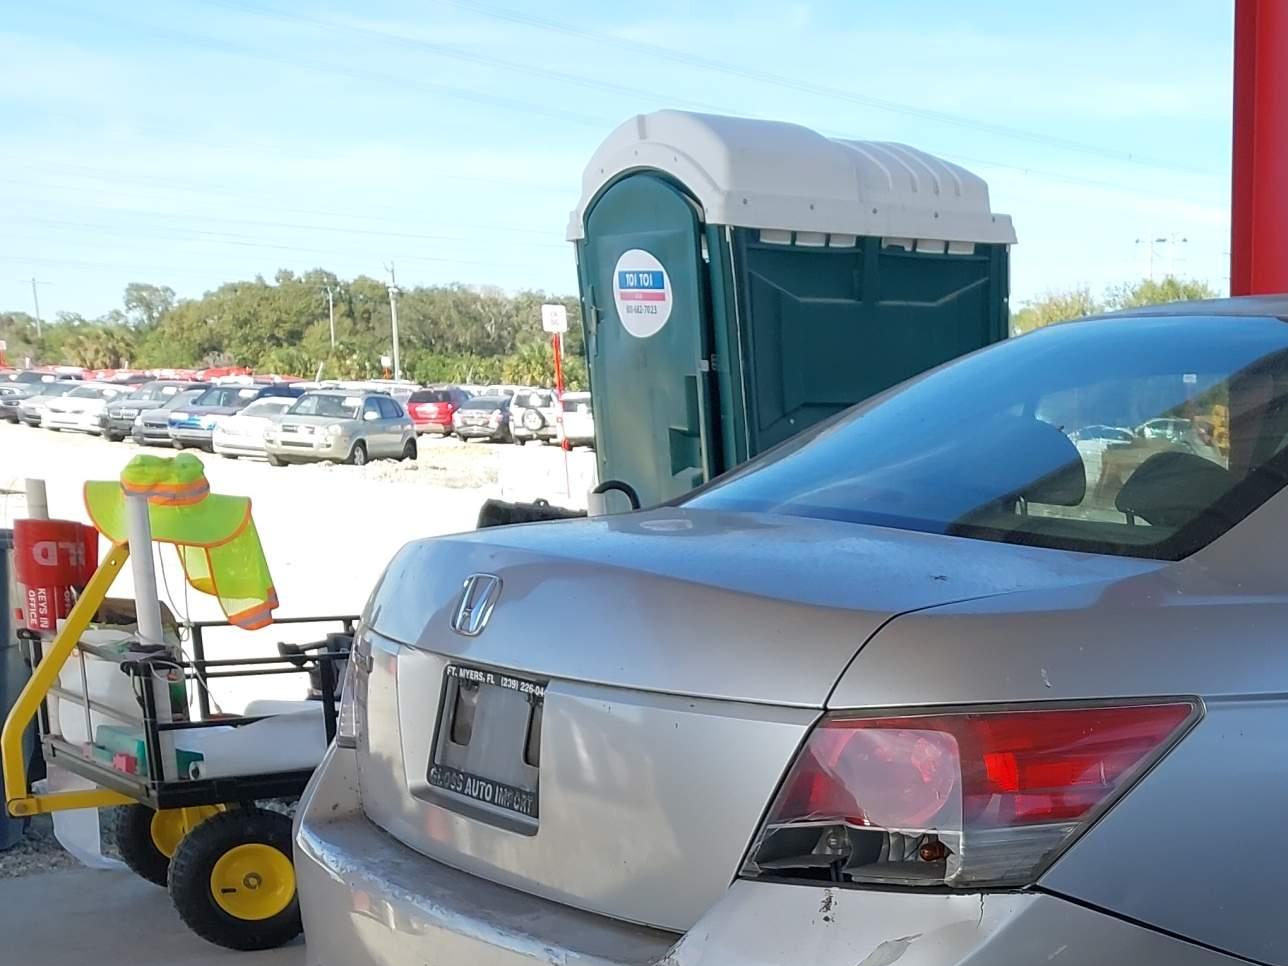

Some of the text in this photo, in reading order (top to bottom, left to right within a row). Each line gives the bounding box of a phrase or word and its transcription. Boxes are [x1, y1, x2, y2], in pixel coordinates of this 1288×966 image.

[625, 272, 653, 287] TOI TOI
[28, 589, 38, 625] OFFICE
[37, 588, 49, 628] KEYS IN
[446, 665, 458, 677] FT.
[459, 668, 486, 683] MYERS,
[487, 673, 495, 684] FL
[501, 676, 519, 690] (239)
[464, 777, 493, 801] AUTO
